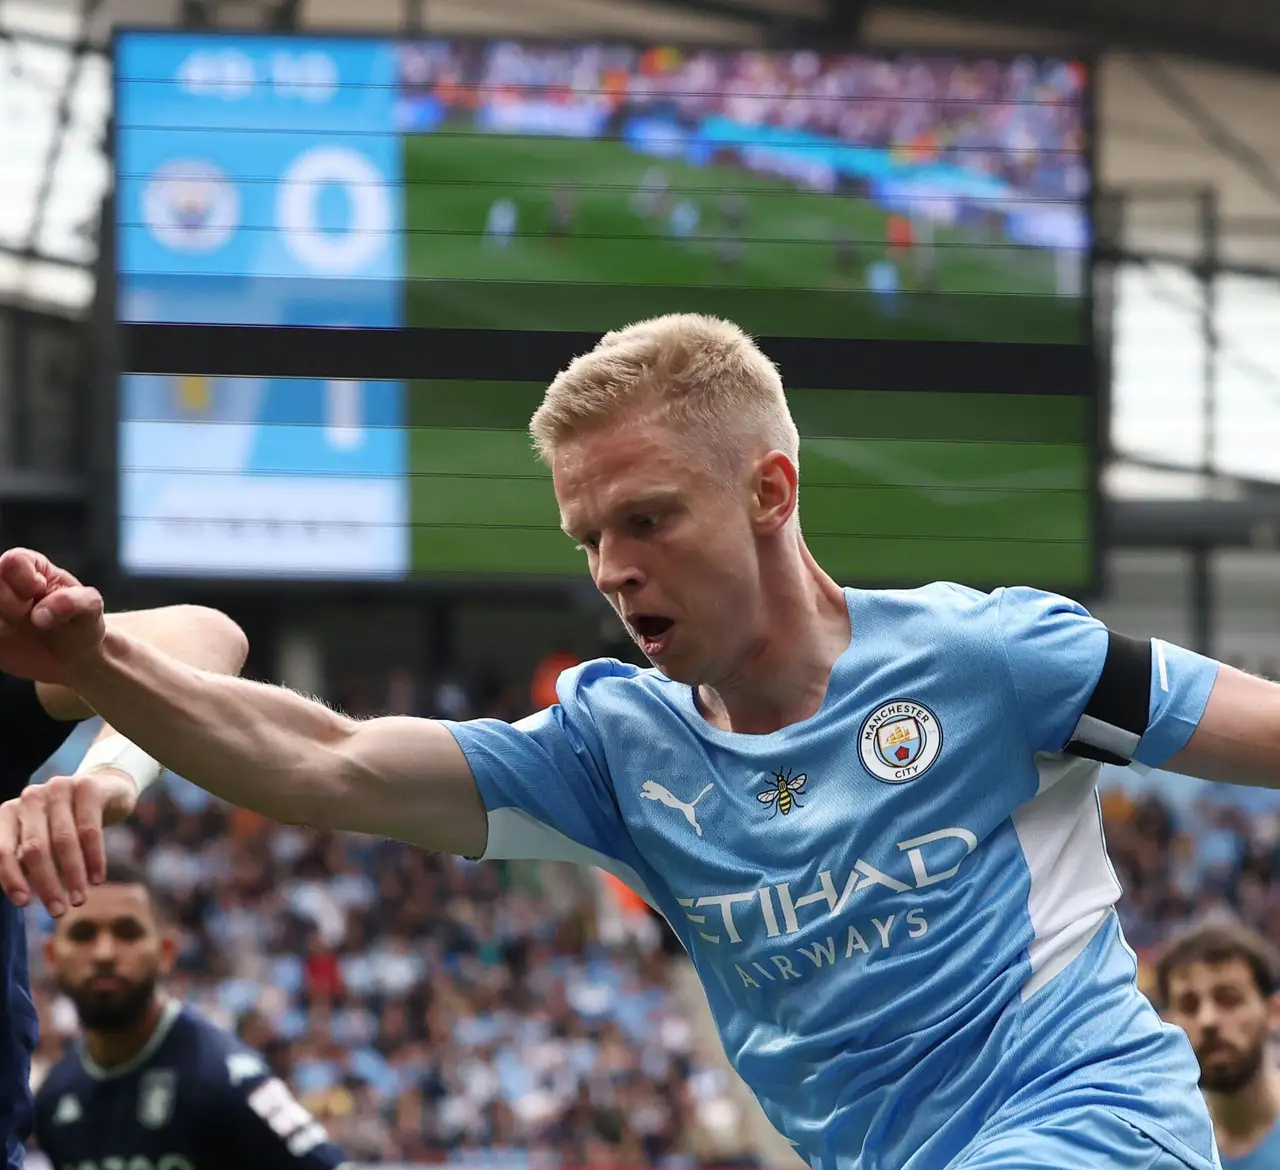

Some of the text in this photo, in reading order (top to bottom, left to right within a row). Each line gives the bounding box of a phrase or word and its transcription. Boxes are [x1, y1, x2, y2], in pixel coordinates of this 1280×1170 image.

[278, 148, 390, 271] 0
[865, 704, 930, 741] MANCHESTER
[894, 765, 919, 779] CITY
[676, 827, 979, 945] ETIHAD
[734, 907, 928, 989] AIRWAYS
